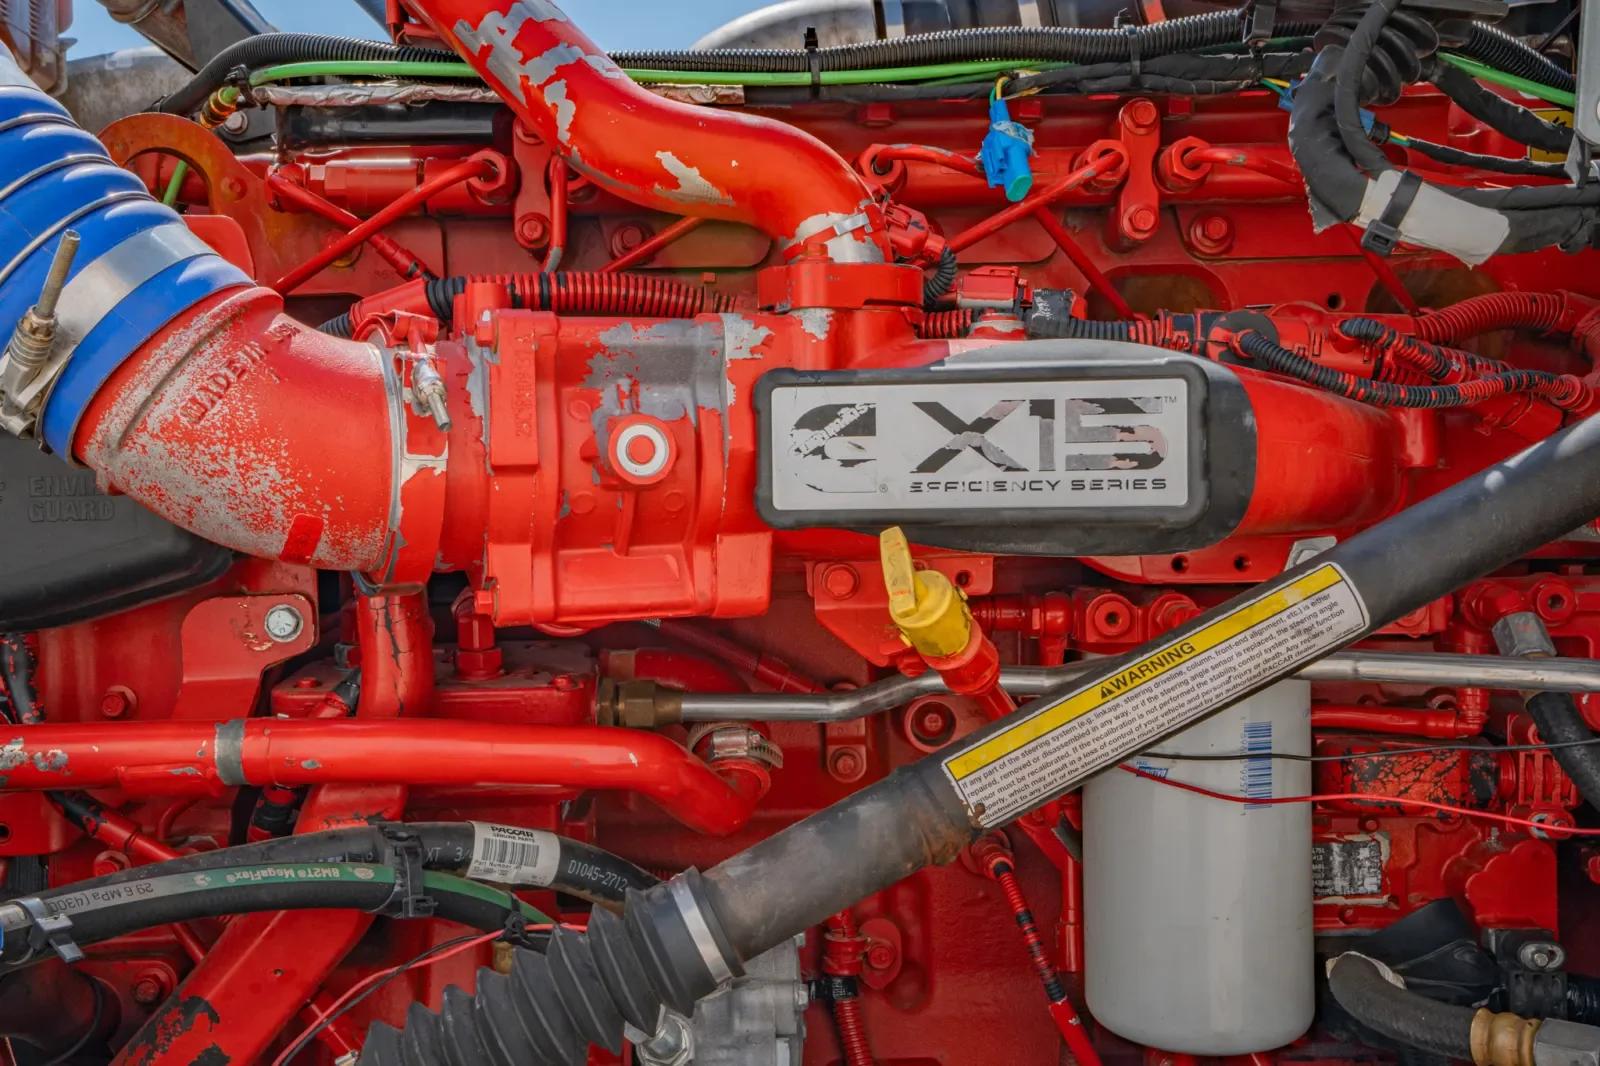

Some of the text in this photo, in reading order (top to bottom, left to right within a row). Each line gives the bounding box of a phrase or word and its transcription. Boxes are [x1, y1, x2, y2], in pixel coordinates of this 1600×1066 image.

[28, 500, 115, 522] GUARD
[1071, 479, 1167, 491] SERIES
[968, 775, 983, 786] any
[982, 765, 999, 779] part
[997, 760, 1007, 770] of
[1006, 754, 1020, 765] the
[1019, 738, 1051, 759] steering
[1050, 724, 1078, 743] system
[1122, 685, 1153, 706] steering
[1214, 635, 1248, 656] front-end
[1301, 603, 1310, 611] is
[1309, 592, 1331, 607] either
[996, 779, 1015, 793] must
[1015, 774, 1026, 783] be
[1078, 739, 1091, 750] the
[1091, 716, 1136, 743] recalibration
[1144, 705, 1158, 715] not
[1157, 685, 1196, 709] performed
[1195, 678, 1208, 688] the
[1208, 664, 1236, 683] stability
[1236, 650, 1262, 667] control
[1262, 636, 1289, 654] system
[1288, 629, 1302, 639] will
[1302, 622, 1315, 632] not
[1315, 607, 1344, 625] function
[998, 760, 1031, 781] removed
[1040, 728, 1091, 759] disassembled
[1090, 724, 1099, 732] in
[1099, 718, 1114, 729] any
[1139, 699, 1147, 707] if
[1146, 693, 1159, 703] the
[1159, 677, 1190, 698] steering
[1188, 666, 1210, 682] angle
[1210, 654, 1234, 670] sensor
[1234, 649, 1242, 657] is
[1275, 625, 1288, 636] the
[1287, 610, 1318, 630] steering
[1317, 599, 1339, 615] angle
[1108, 640, 1196, 692] WARNING
[983, 795, 1008, 811] operly,
[1007, 783, 1030, 798] which
[1030, 775, 1046, 787] may
[1046, 763, 1068, 777] result
[1068, 758, 1076, 766] in
[1082, 747, 1098, 759] loss
[1098, 742, 1107, 750] of
[1107, 728, 1134, 745] control
[1133, 724, 1142, 732] of
[1142, 716, 1160, 728] your
[1159, 701, 1186, 718] vehicle
[1185, 693, 1200, 704] and
[1200, 677, 1232, 697] personal
[1231, 666, 1253, 681] injury
[1284, 642, 1299, 653] Any
[1299, 628, 1325, 646] repairs
[1028, 787, 1041, 797] any
[1042, 777, 1058, 789] part
[1066, 766, 1079, 775] the
[1079, 750, 1110, 770] steering
[1110, 736, 1137, 754] system
[1136, 726, 1155, 738] must
[1165, 701, 1204, 724] performed
[1203, 696, 1213, 704] by
[1261, 653, 1293, 673] PACCAR
[490, 826, 533, 838] PACCAR
[92, 888, 122, 900] MPa
